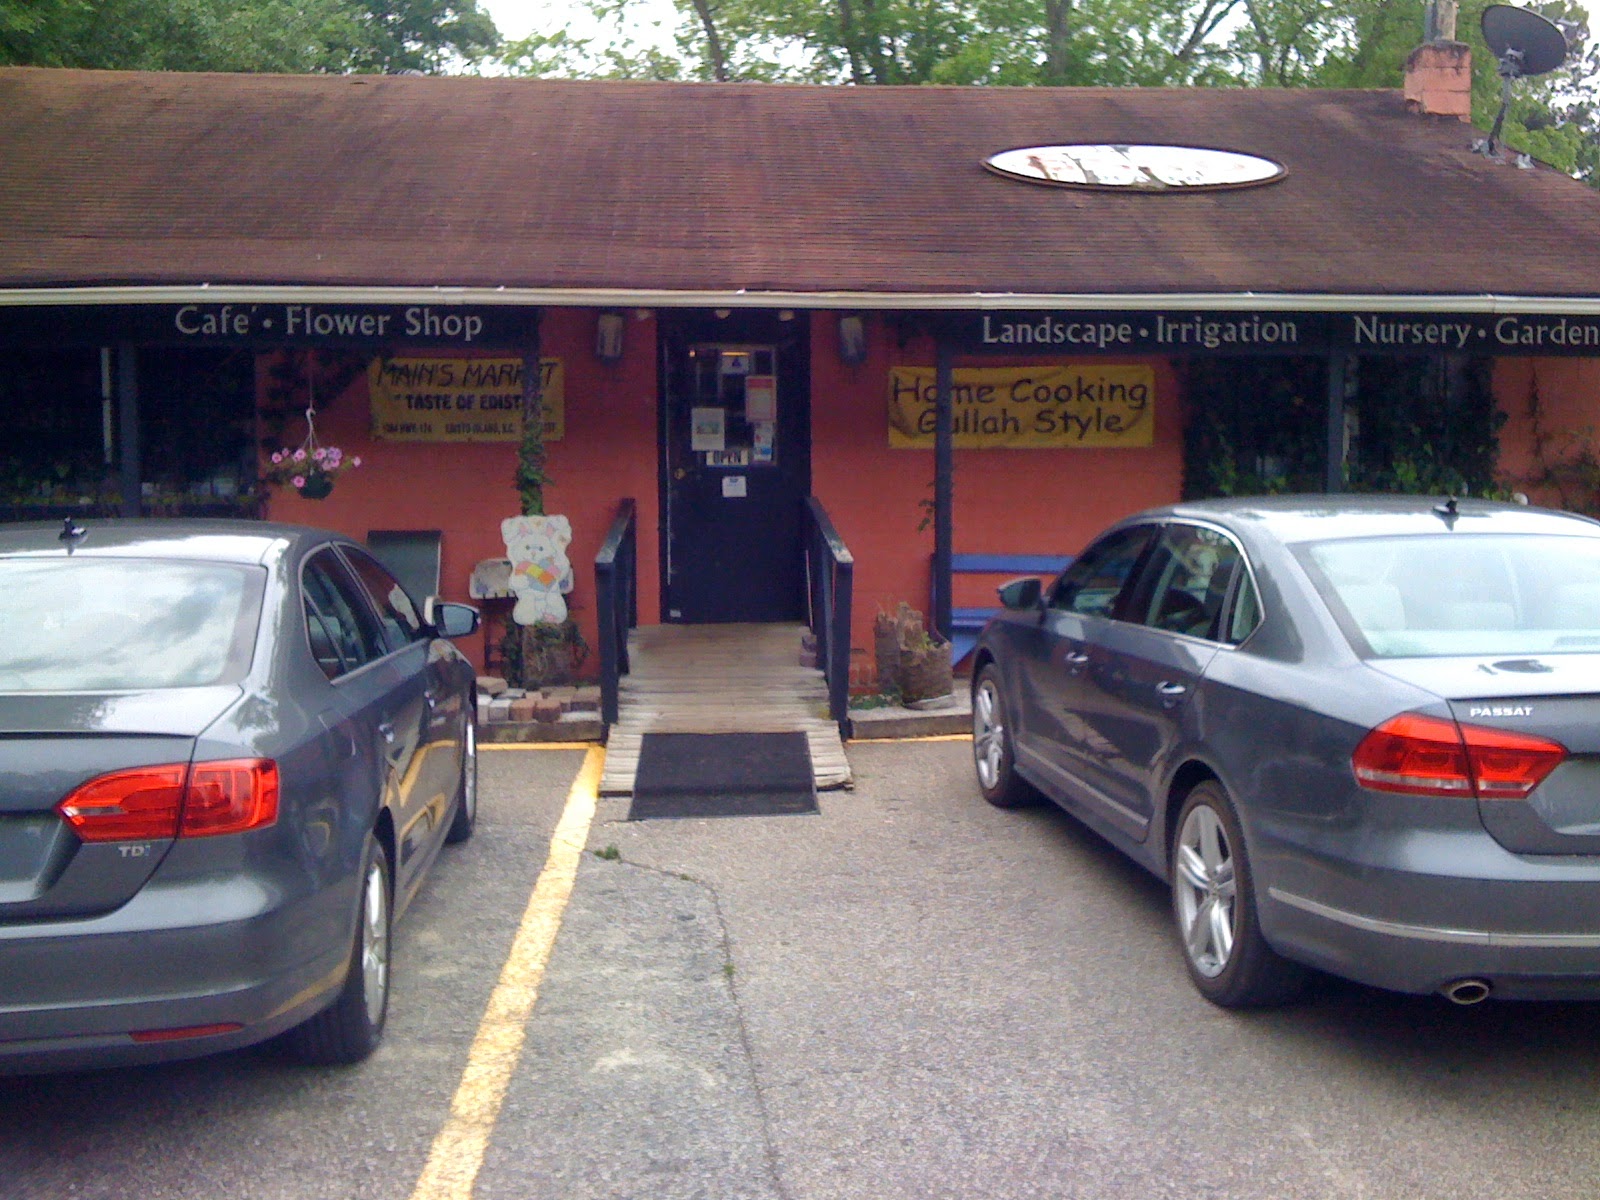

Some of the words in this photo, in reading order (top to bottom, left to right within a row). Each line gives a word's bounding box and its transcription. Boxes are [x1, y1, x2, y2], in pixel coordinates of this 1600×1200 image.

[286, 307, 391, 336] Flower
[405, 307, 483, 341] Shop
[982, 316, 1132, 347] Landscape
[1157, 316, 1298, 348] Irrigation
[1354, 315, 1472, 348] Nursery
[1495, 317, 1600, 345] Garden
[462, 362, 558, 387] MARKT
[893, 376, 997, 405] Home
[1010, 376, 1149, 409] Cooking
[1034, 406, 1124, 440] Style
[1469, 706, 1534, 717] PASSAT
